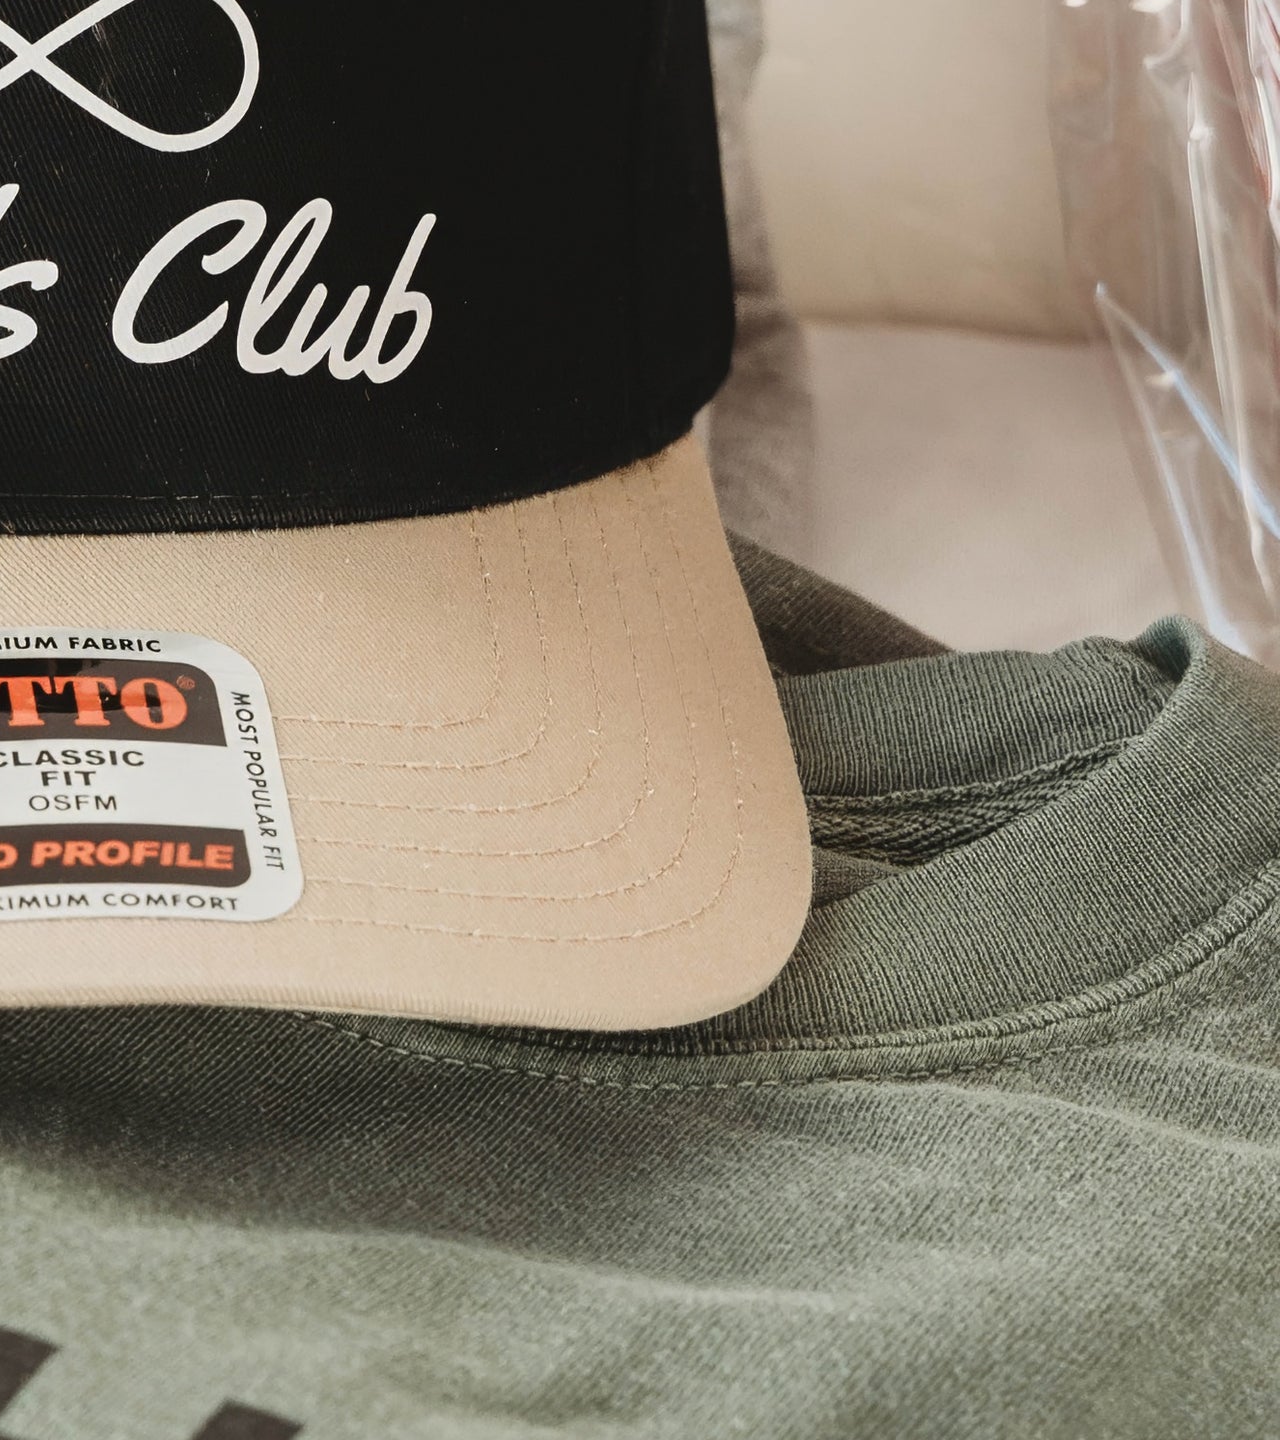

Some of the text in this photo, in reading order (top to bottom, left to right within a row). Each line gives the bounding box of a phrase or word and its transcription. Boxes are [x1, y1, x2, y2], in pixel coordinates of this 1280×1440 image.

[111, 197, 437, 384] Club
[68, 635, 163, 653] FABRIC
[40, 770, 97, 787] FIT
[230, 691, 285, 871] MOST POPULAR FIT
[28, 794, 119, 812] OSFM
[30, 840, 236, 871] PROFILE
[103, 893, 239, 912] COMFORT
